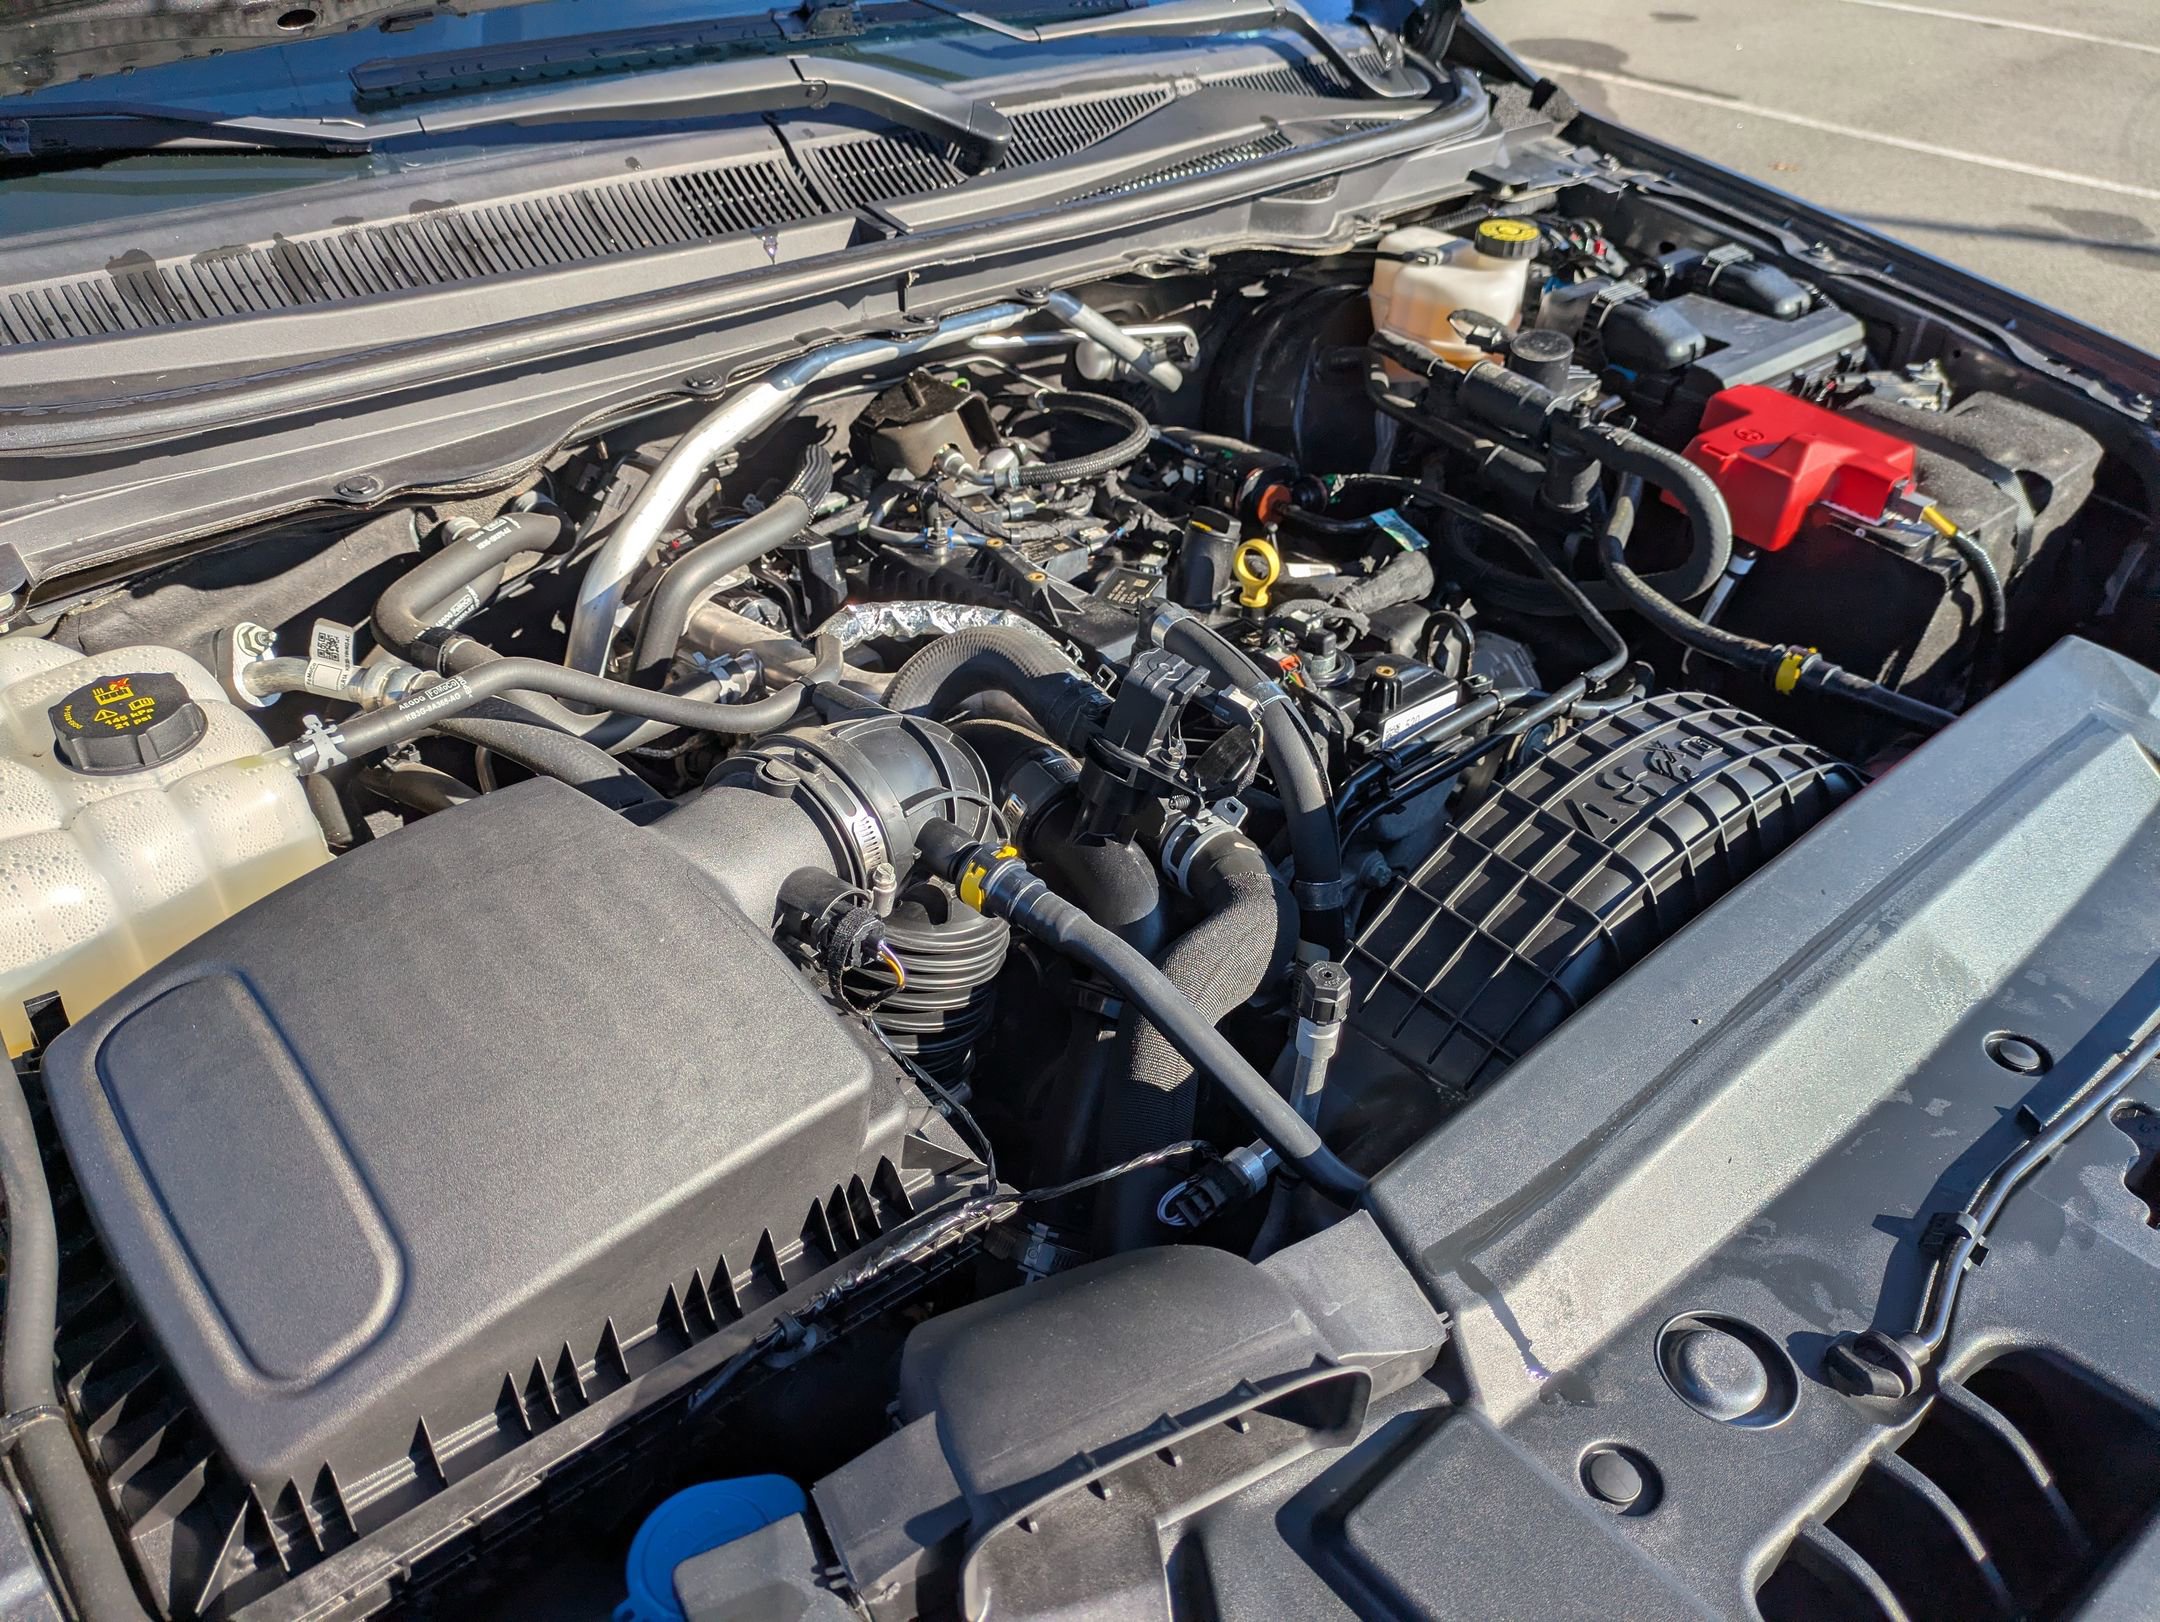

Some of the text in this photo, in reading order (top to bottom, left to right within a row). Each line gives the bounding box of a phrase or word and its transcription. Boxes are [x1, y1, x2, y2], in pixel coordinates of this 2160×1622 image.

[426, 680, 459, 698] FoMoCo
[105, 709, 154, 725] 145 kPa
[115, 715, 152, 729] 21 psi
